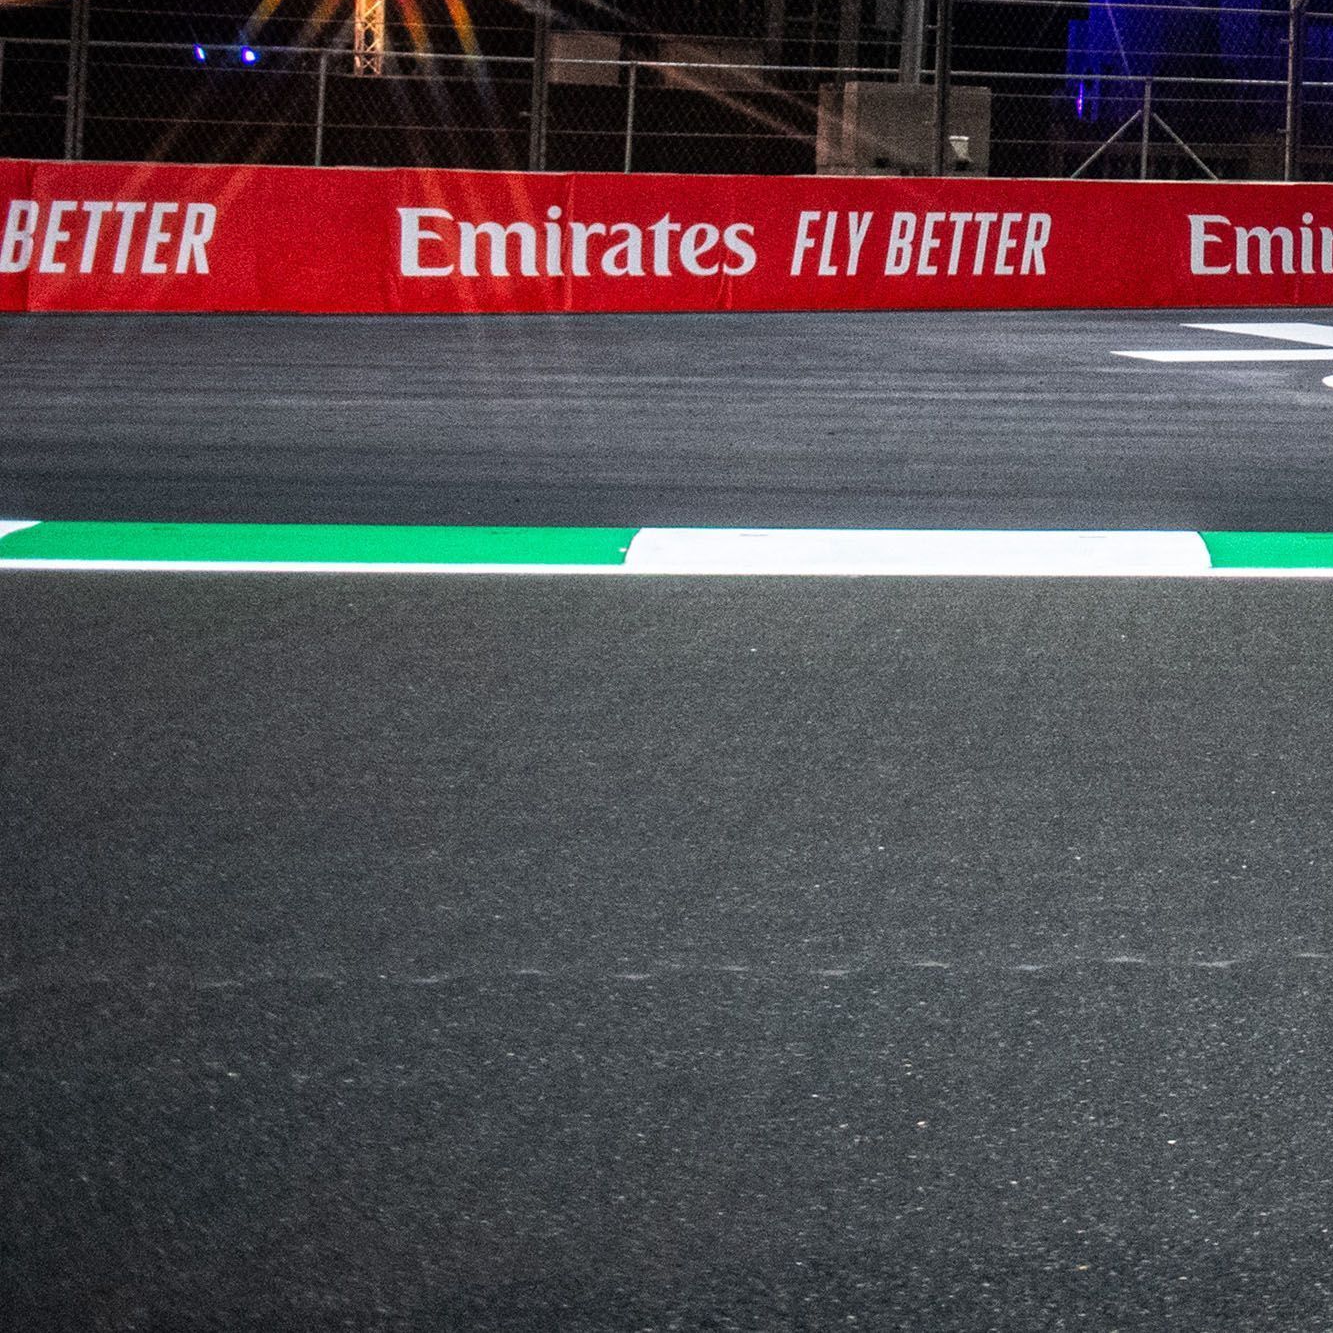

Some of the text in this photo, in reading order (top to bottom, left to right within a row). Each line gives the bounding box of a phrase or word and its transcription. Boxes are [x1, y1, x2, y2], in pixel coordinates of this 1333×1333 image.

[0, 200, 217, 274] BETTER
[397, 206, 1051, 277] Emirates FLY BETTER
